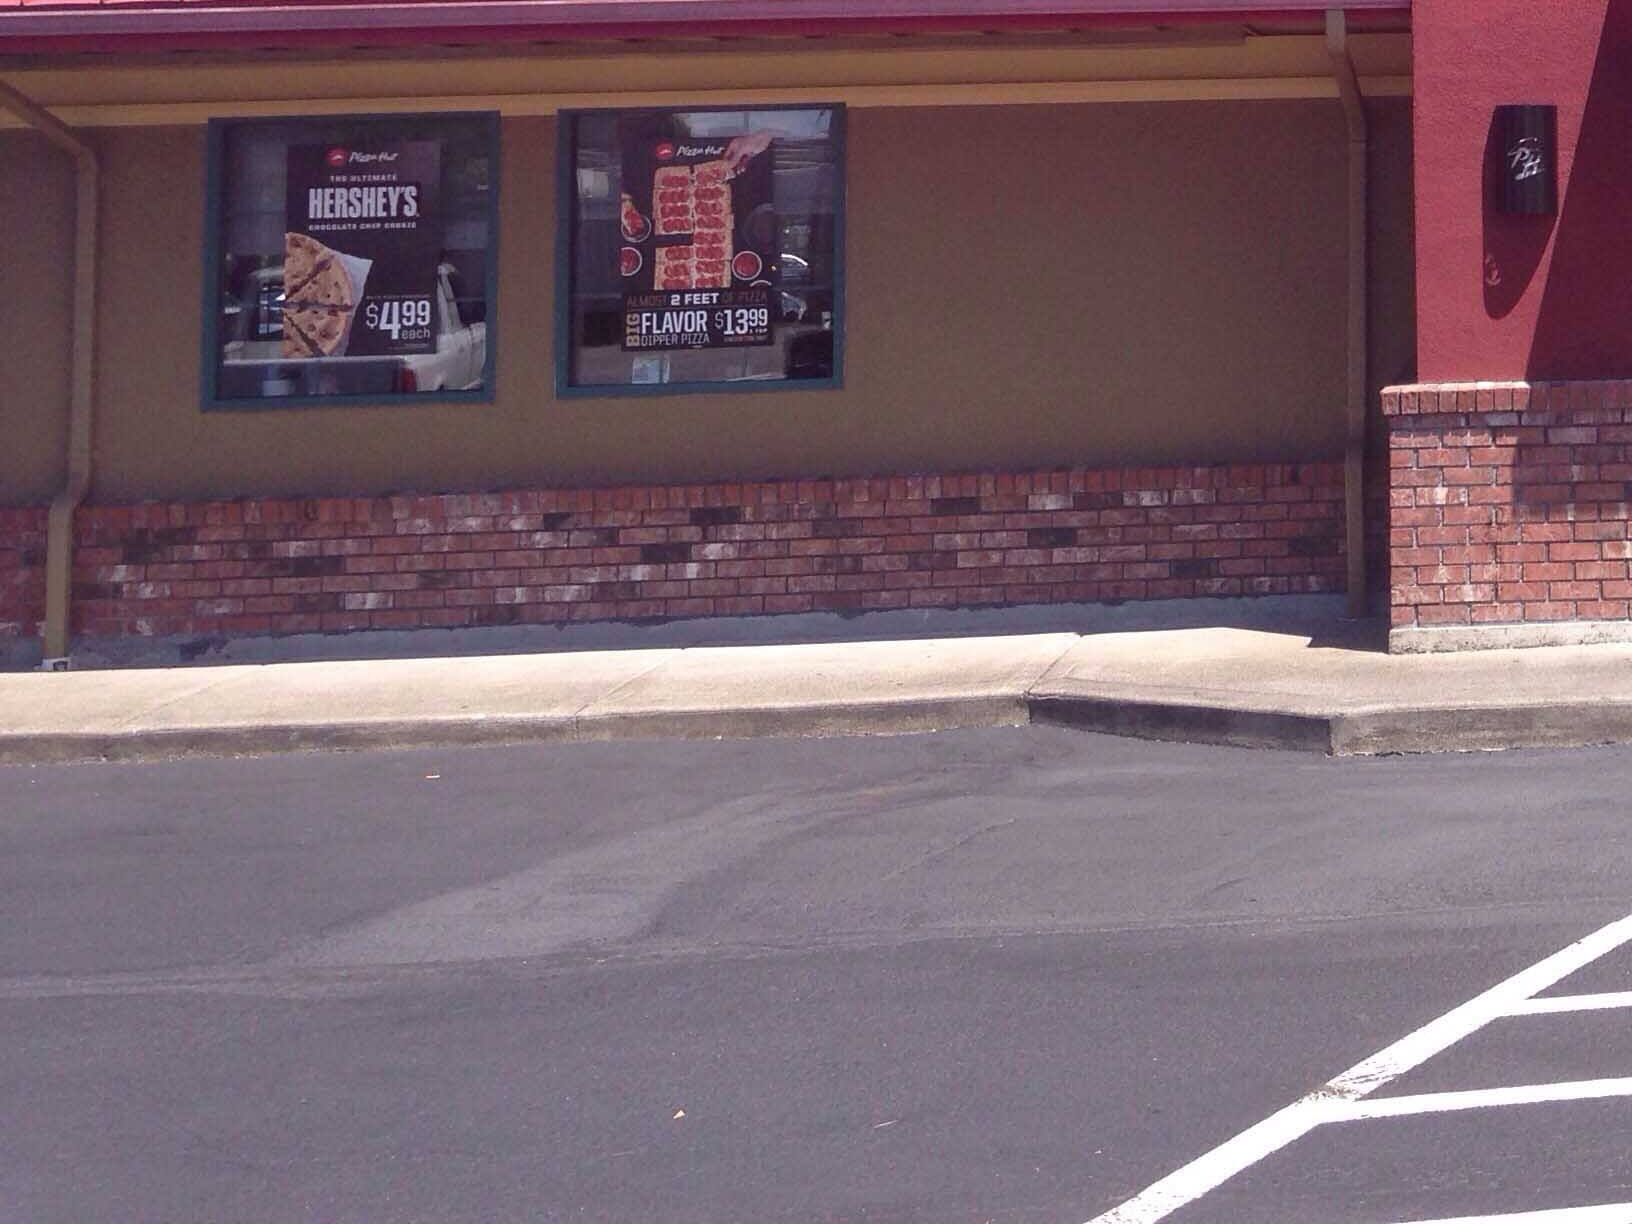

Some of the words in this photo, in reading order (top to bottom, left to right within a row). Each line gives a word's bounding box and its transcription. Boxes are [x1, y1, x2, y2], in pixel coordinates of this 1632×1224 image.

[676, 146, 703, 157] Pizza
[705, 146, 725, 155] Hut
[308, 185, 418, 218] HERSHEY'S
[671, 294, 681, 306] 2
[684, 292, 720, 305] FEET
[641, 310, 708, 335] FLAVOR
[401, 327, 431, 340] each
[626, 313, 641, 347] BIG
[641, 333, 679, 345] DIPPER
[681, 332, 710, 344] PIZZA
